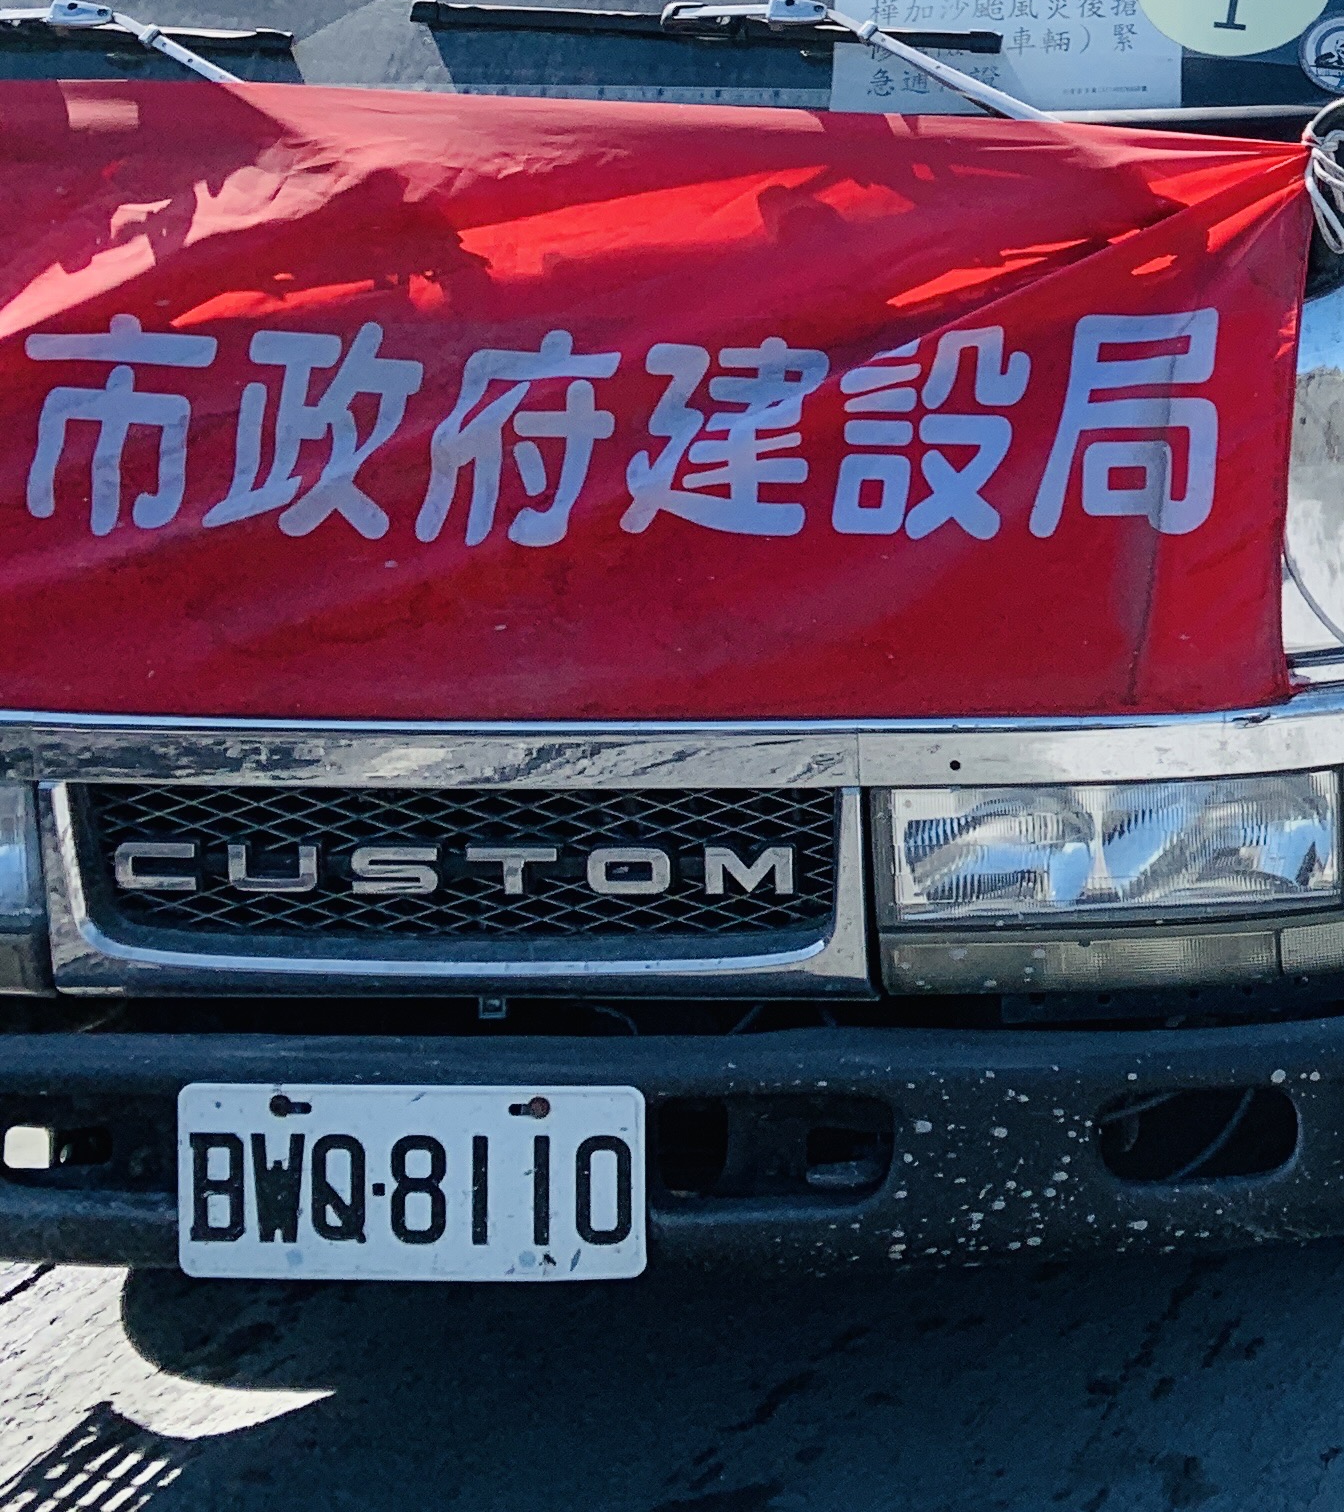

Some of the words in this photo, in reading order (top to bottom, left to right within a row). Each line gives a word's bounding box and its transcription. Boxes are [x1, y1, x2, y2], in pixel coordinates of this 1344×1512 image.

[24, 307, 1219, 546] 市政府建設局
[114, 841, 794, 895] CUSTOM
